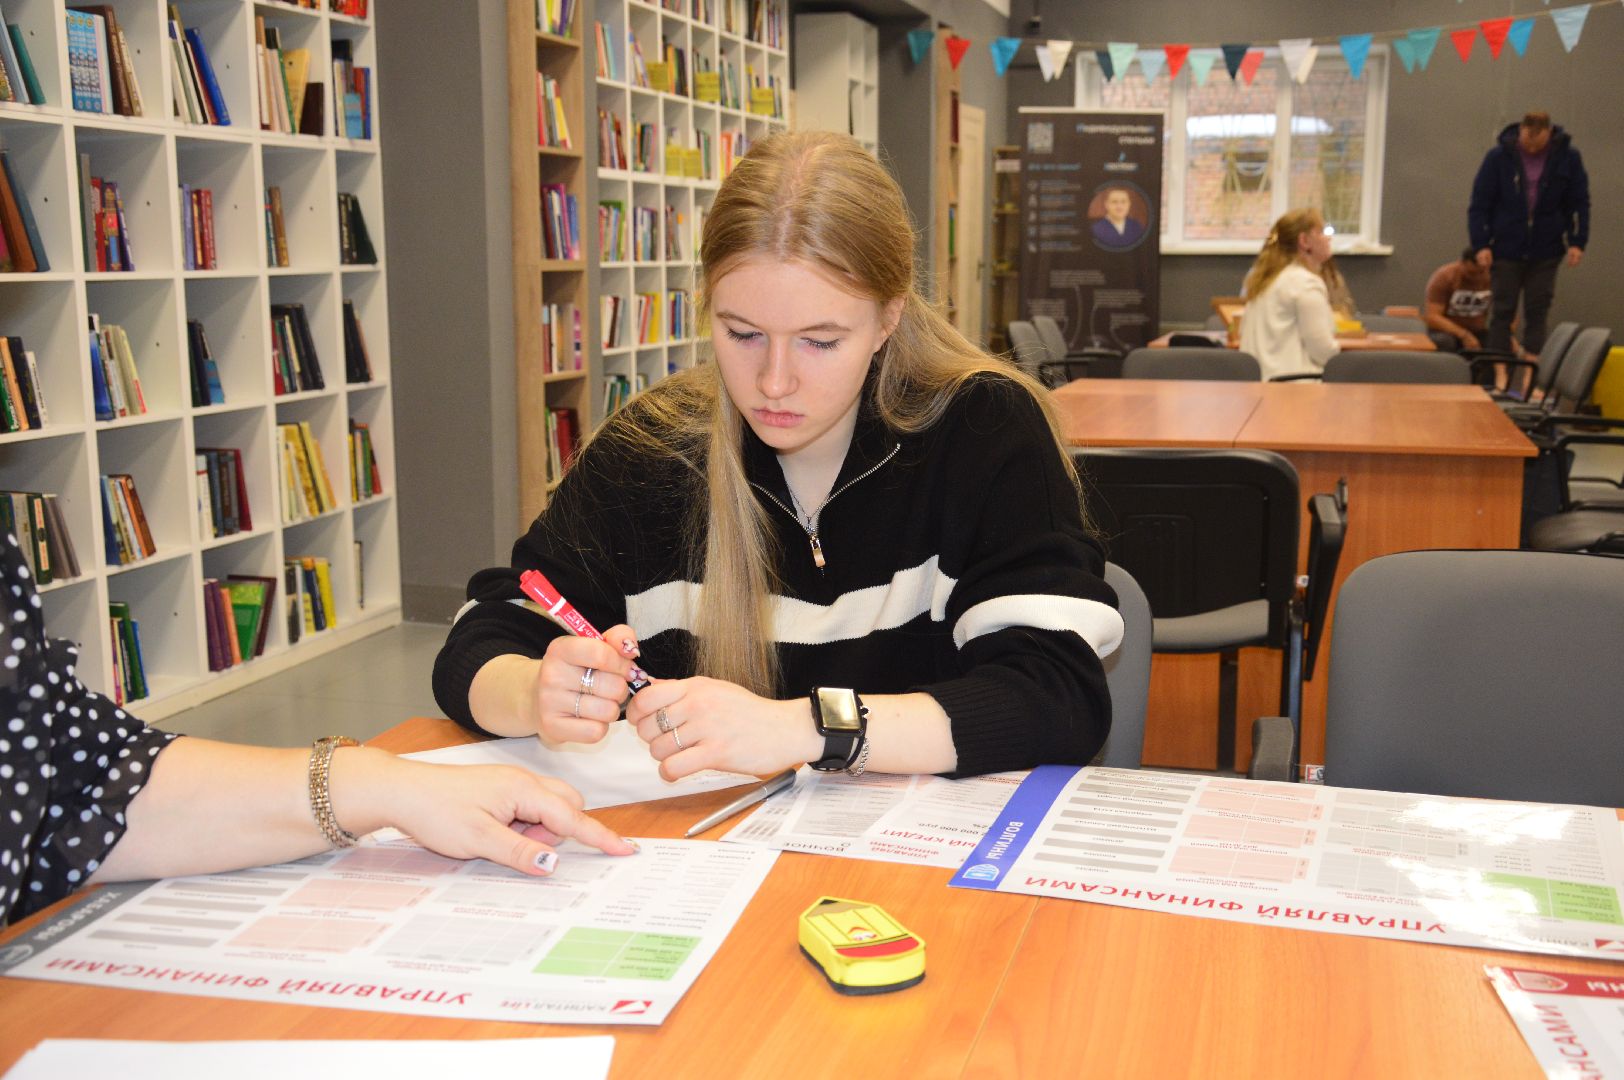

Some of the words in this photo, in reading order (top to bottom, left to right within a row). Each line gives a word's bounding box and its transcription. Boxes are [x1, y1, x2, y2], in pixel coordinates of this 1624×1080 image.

[880, 829, 942, 843] КРЕДИТ
[986, 821, 1024, 859] ВОЛГИНЫ
[1024, 876, 1243, 911] ФИНАНСАМИ
[1256, 903, 1447, 934] УПРАВЛЯЙ
[46, 957, 269, 988] ФИНАНСАМИ
[279, 978, 473, 1005] УПРАВЛЯЙ
